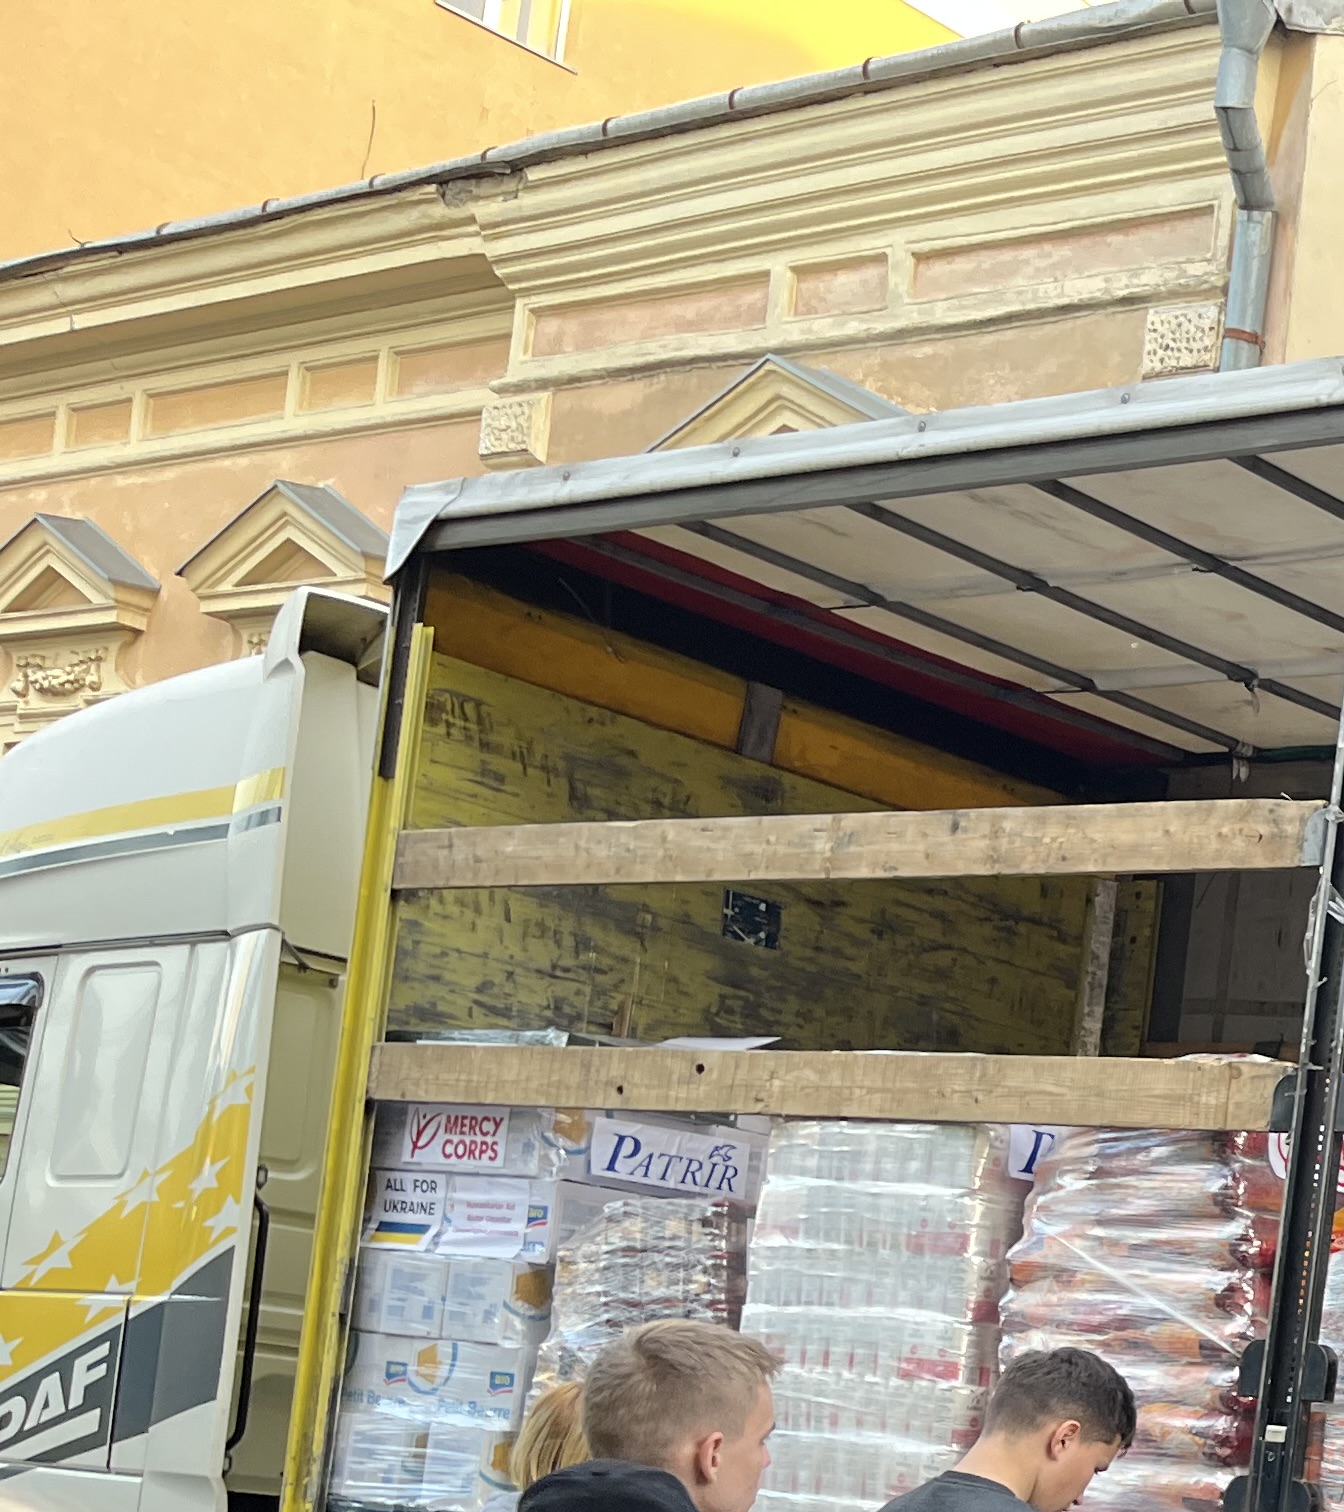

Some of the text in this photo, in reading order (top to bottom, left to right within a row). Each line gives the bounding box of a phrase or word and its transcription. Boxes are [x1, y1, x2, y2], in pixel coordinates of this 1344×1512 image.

[443, 1114, 505, 1138] MERCY
[441, 1139, 499, 1162] CORPS
[601, 1132, 739, 1193] PATRIR
[385, 1177, 438, 1194] ALL FOR
[383, 1199, 436, 1216] UKRAINE
[0, 1340, 111, 1444] DAF
